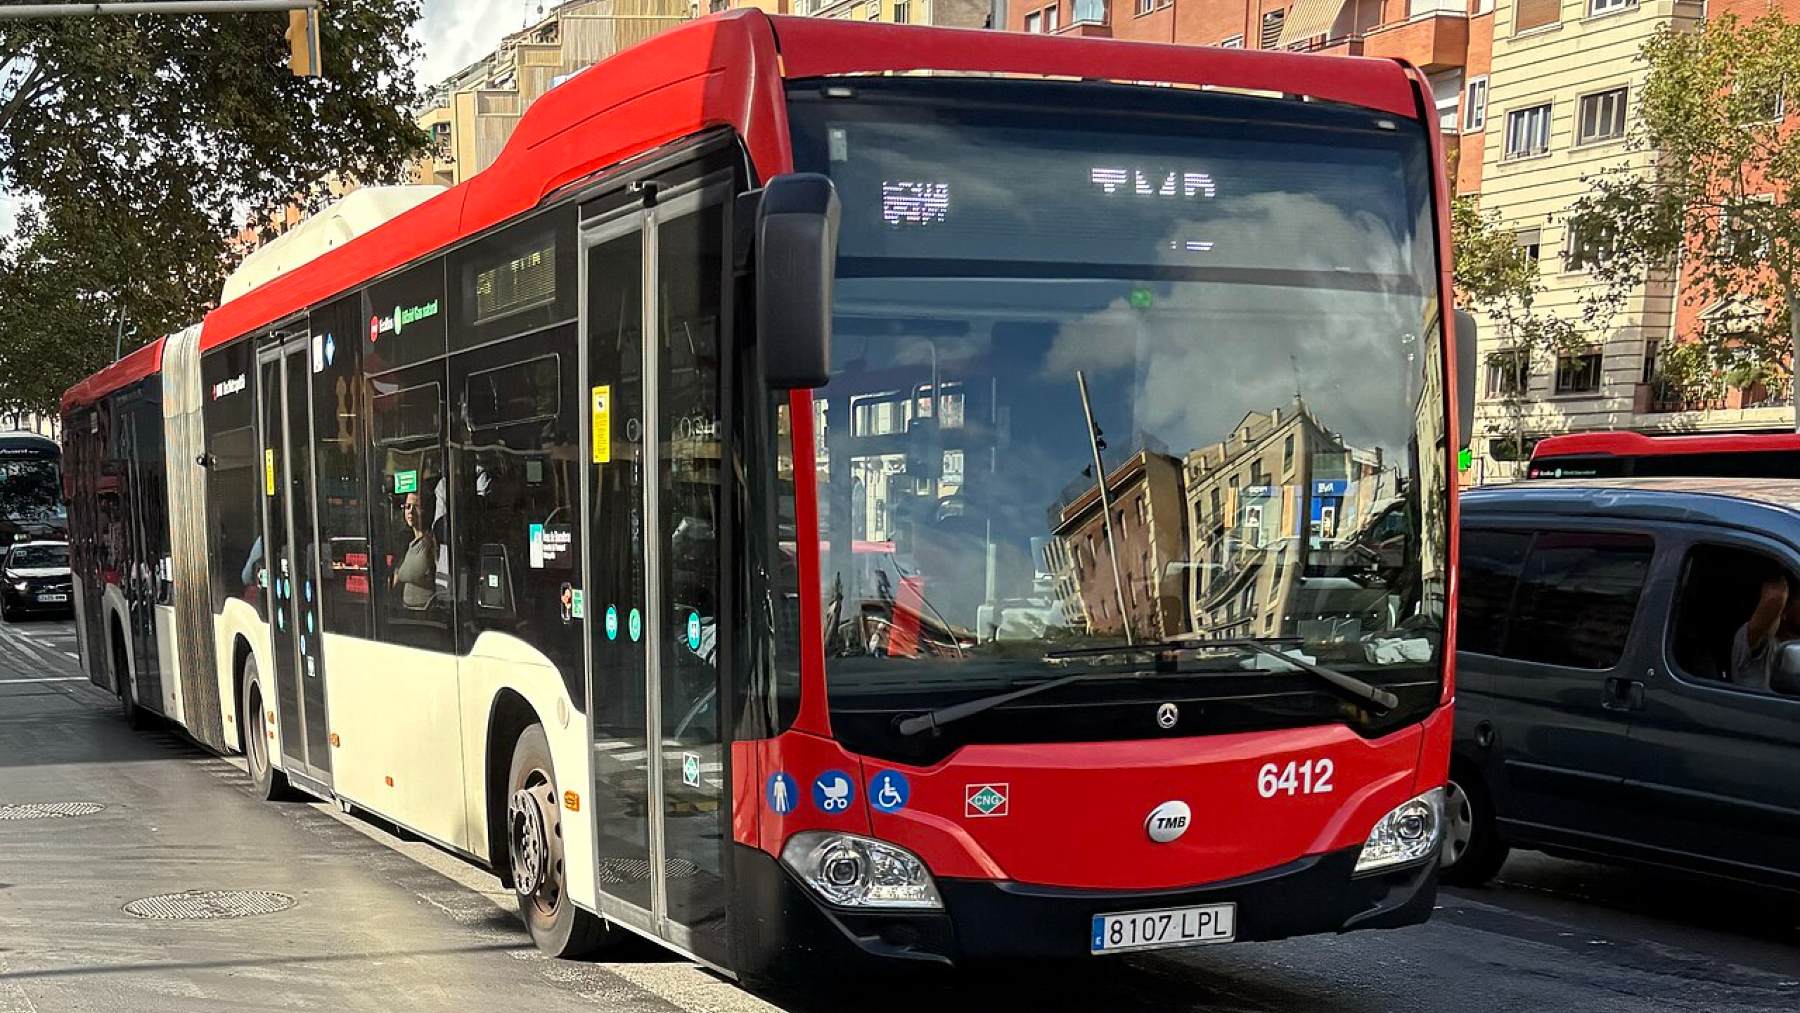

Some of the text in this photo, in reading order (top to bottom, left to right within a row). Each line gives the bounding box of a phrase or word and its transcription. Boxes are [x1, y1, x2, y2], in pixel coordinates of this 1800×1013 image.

[1257, 758, 1334, 798] 6412
[974, 794, 999, 806] CNG
[1156, 816, 1187, 830] TMB
[1110, 910, 1227, 945] 8107 LPL
